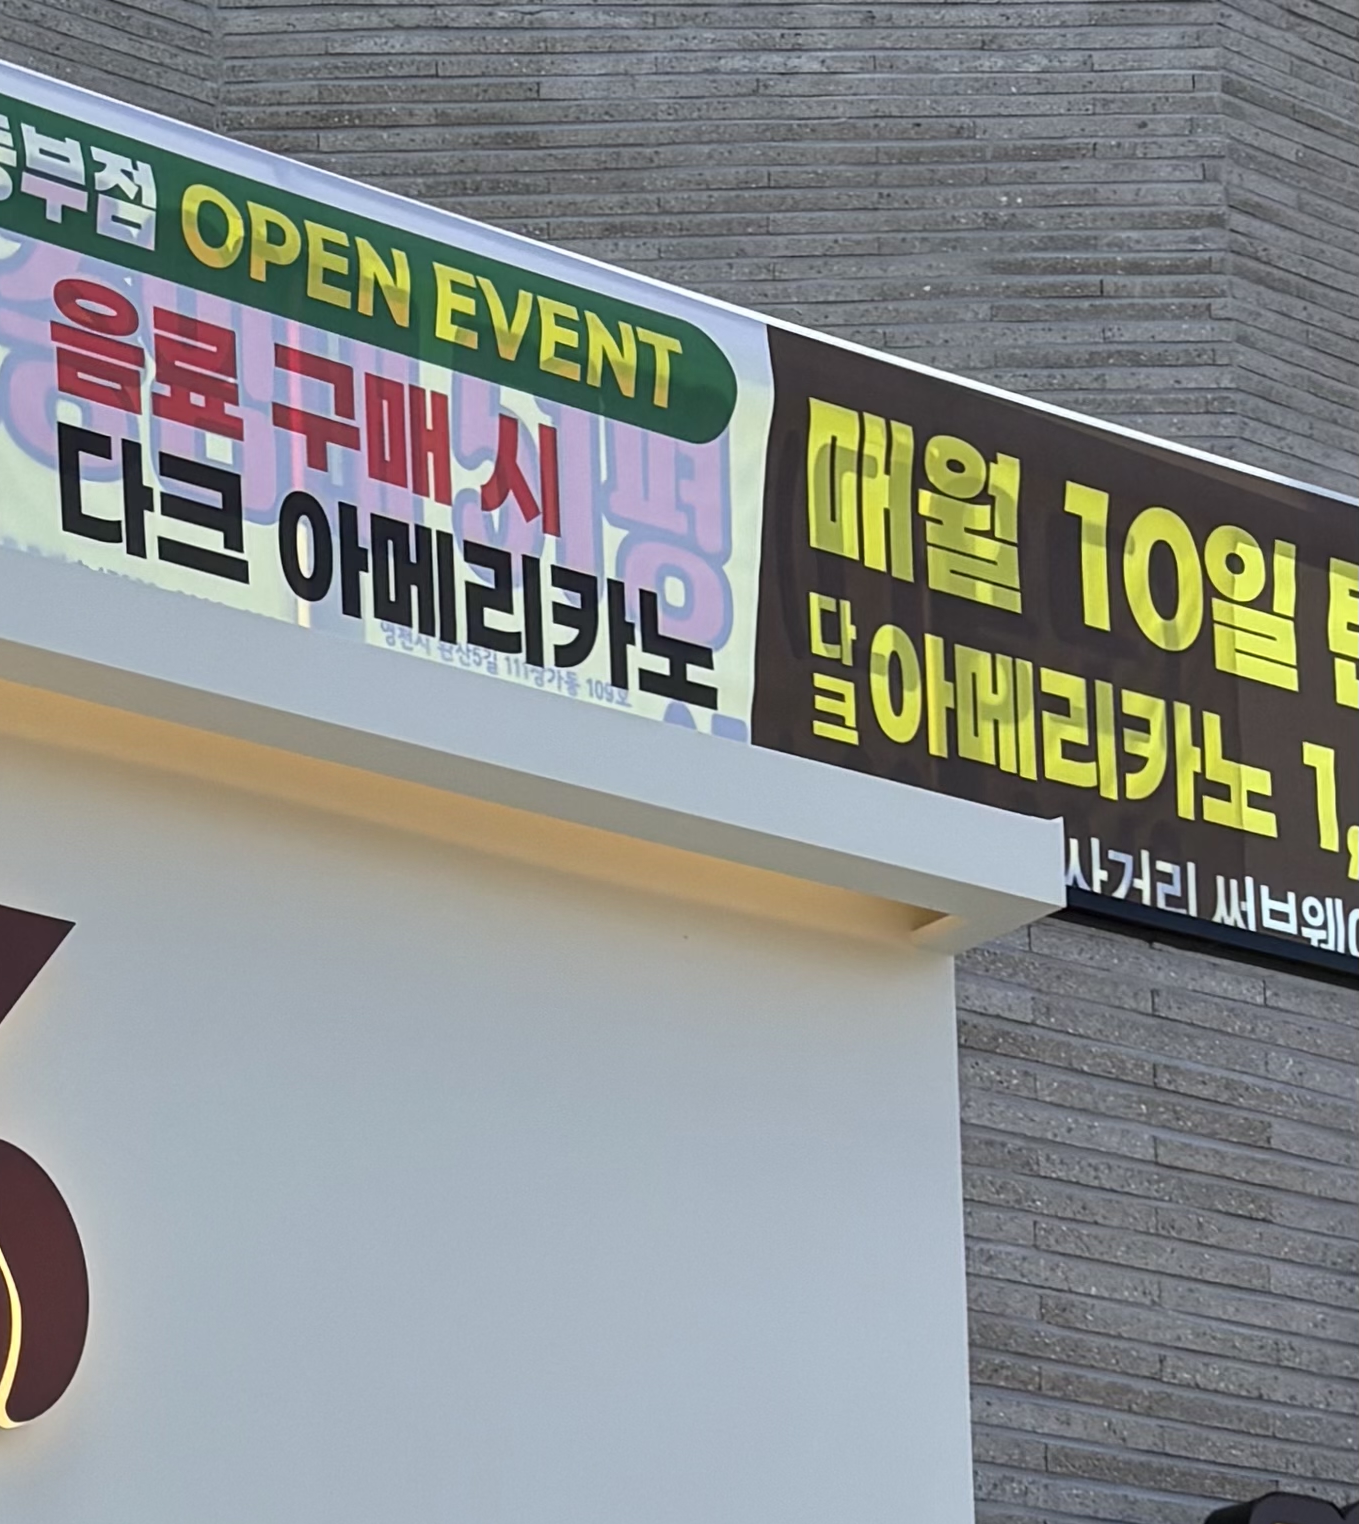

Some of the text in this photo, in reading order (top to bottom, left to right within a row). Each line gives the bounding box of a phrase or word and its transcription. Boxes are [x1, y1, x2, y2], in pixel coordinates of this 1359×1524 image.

[49, 277, 245, 443] 음료
[272, 341, 453, 508] 구매
[481, 411, 561, 538] 시
[182, 183, 411, 328] OPEN
[433, 260, 683, 409] EVENT
[57, 421, 250, 586] 다크
[278, 489, 719, 711] 아메리카노
[808, 396, 1023, 614] 매월
[1064, 479, 1300, 693] 10일
[808, 591, 860, 746] 다크
[869, 623, 1280, 839] 아메리카노
